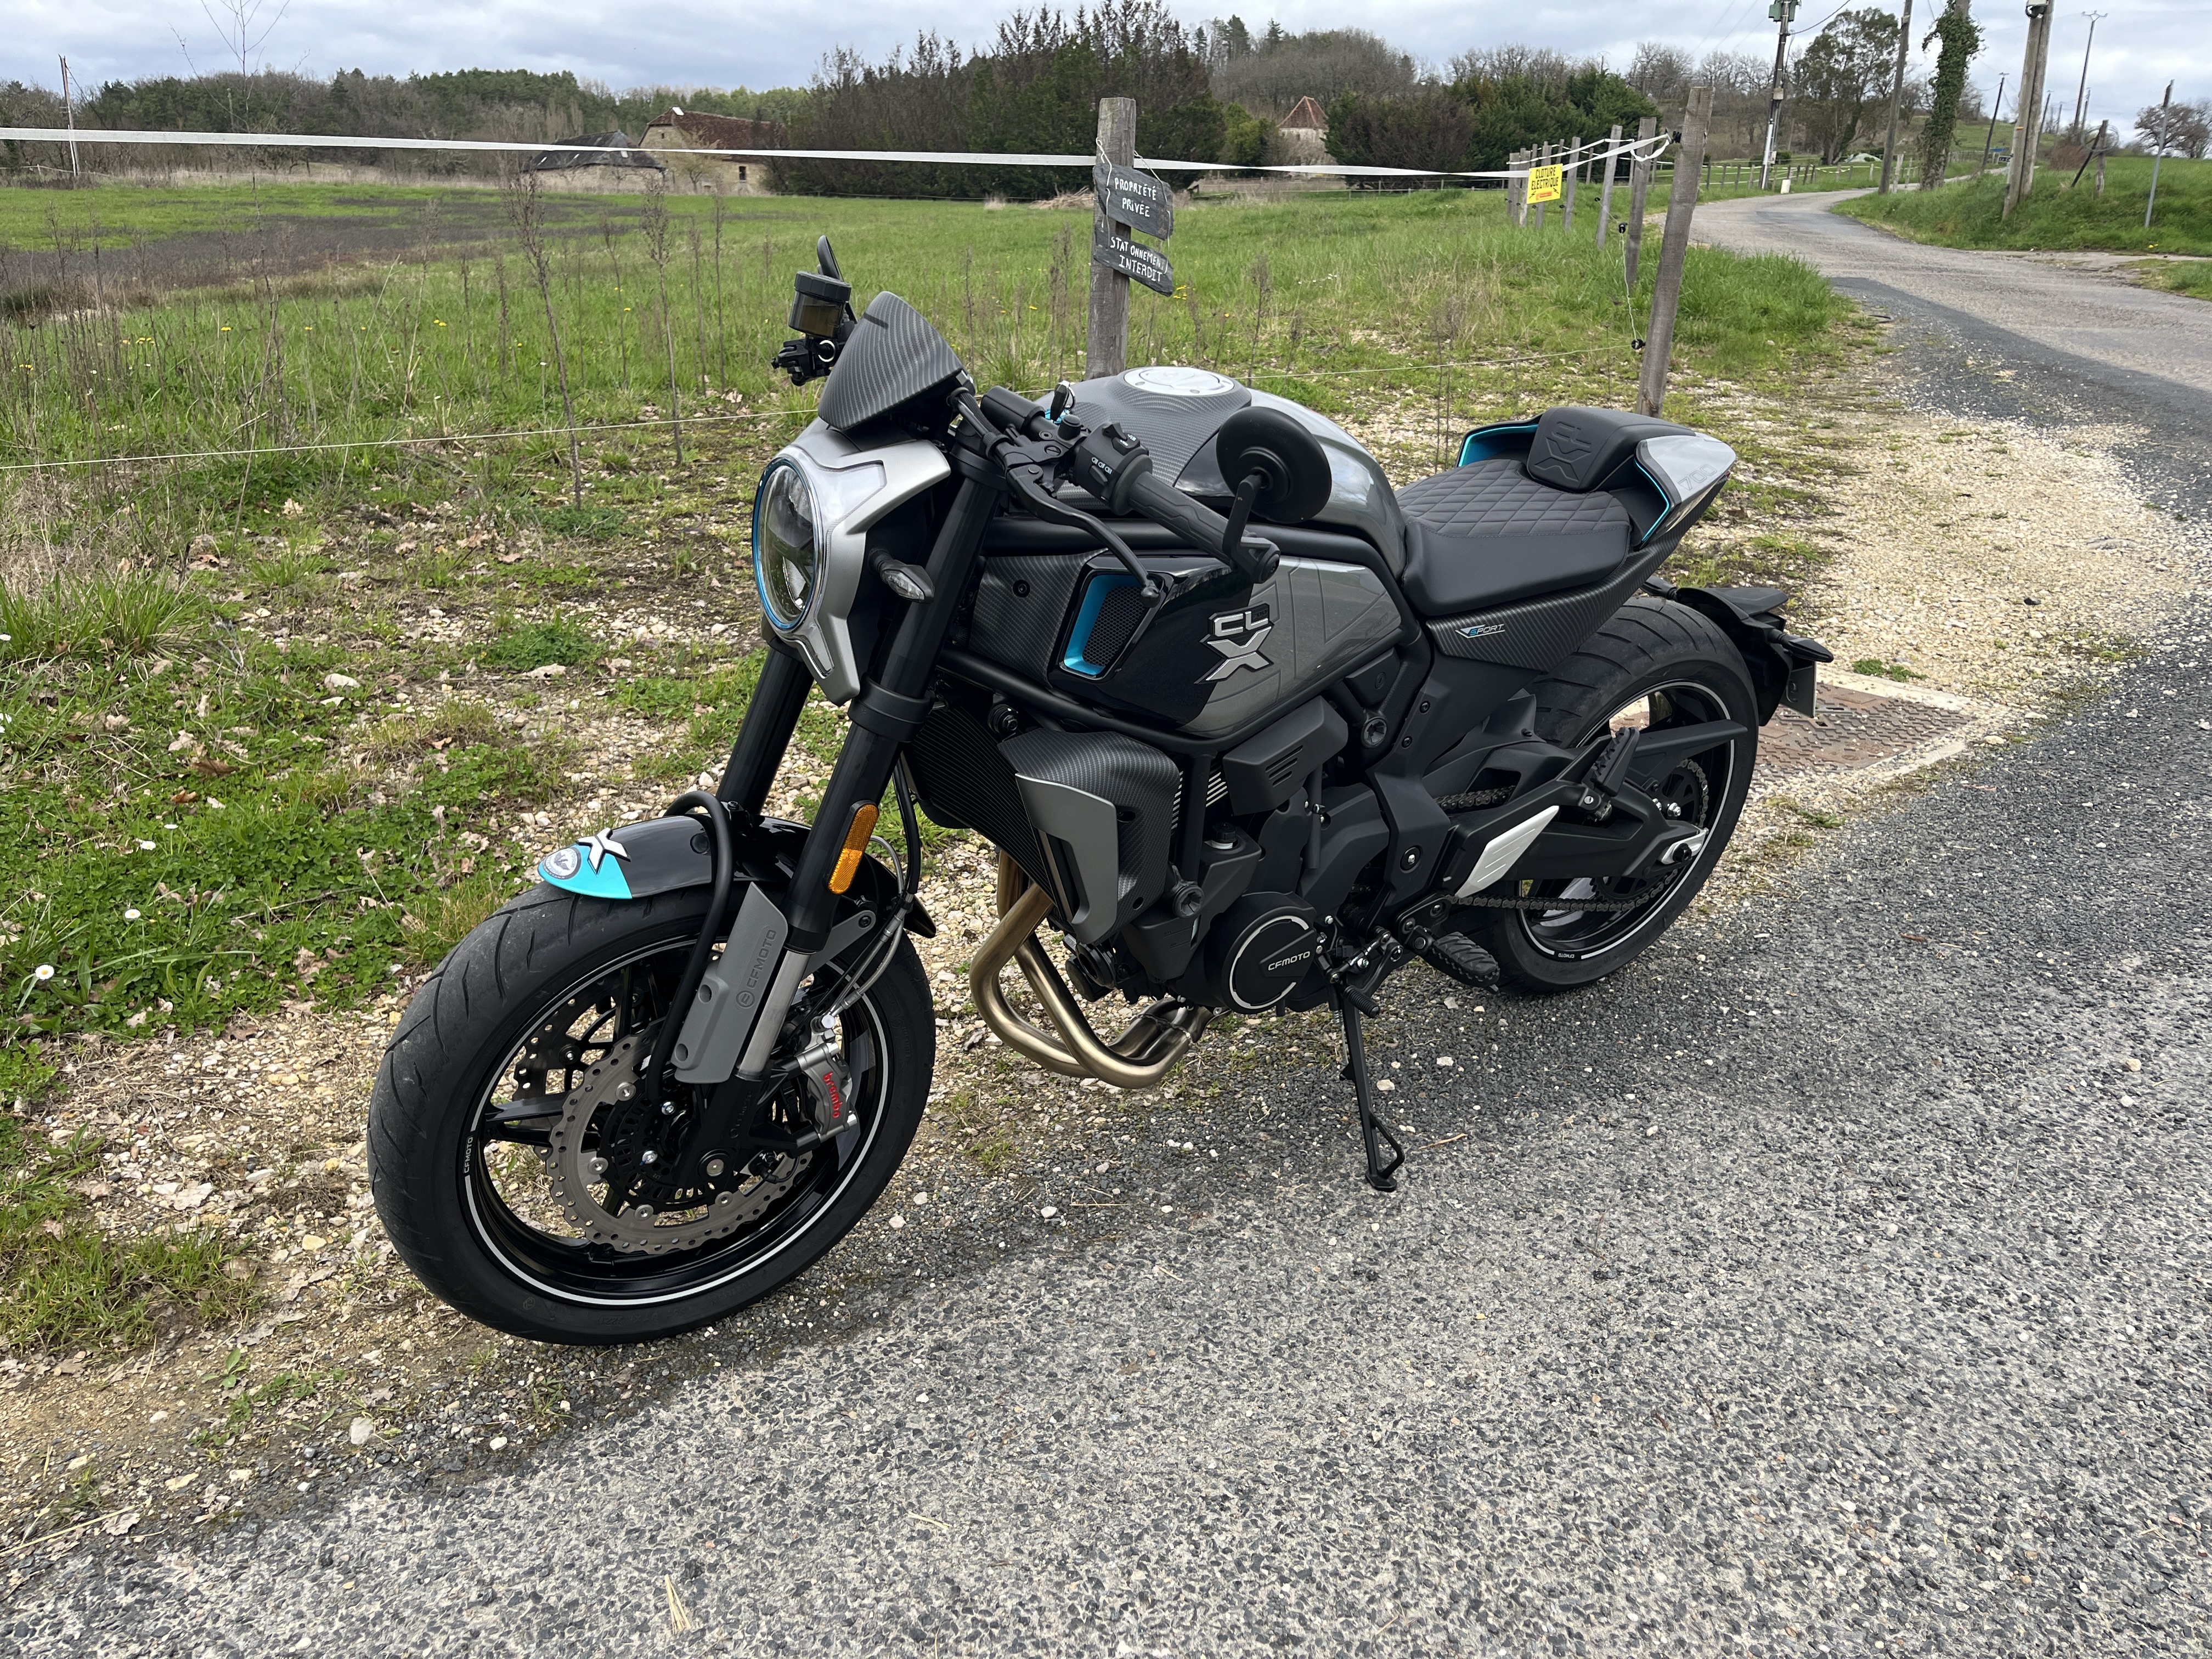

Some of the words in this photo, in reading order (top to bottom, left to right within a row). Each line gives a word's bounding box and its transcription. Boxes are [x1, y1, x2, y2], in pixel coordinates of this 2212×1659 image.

[1531, 177, 1559, 190] ELECTRIQUE
[1536, 166, 1556, 179] CLOTURE
[1114, 177, 1156, 200] PROPRIÉTÉ
[1122, 198, 1150, 217] PRIVÉE
[1110, 236, 1166, 270] STATONNEMENT
[1118, 255, 1163, 282] INTERDIT
[1677, 464, 1718, 492] 700
[1469, 623, 1504, 635] SPORT
[746, 929, 777, 989] CFMOTO
[1268, 951, 1311, 971] CFMOTO
[822, 1071, 843, 1119] brembo
[464, 1137, 473, 1174] CFMOTO
